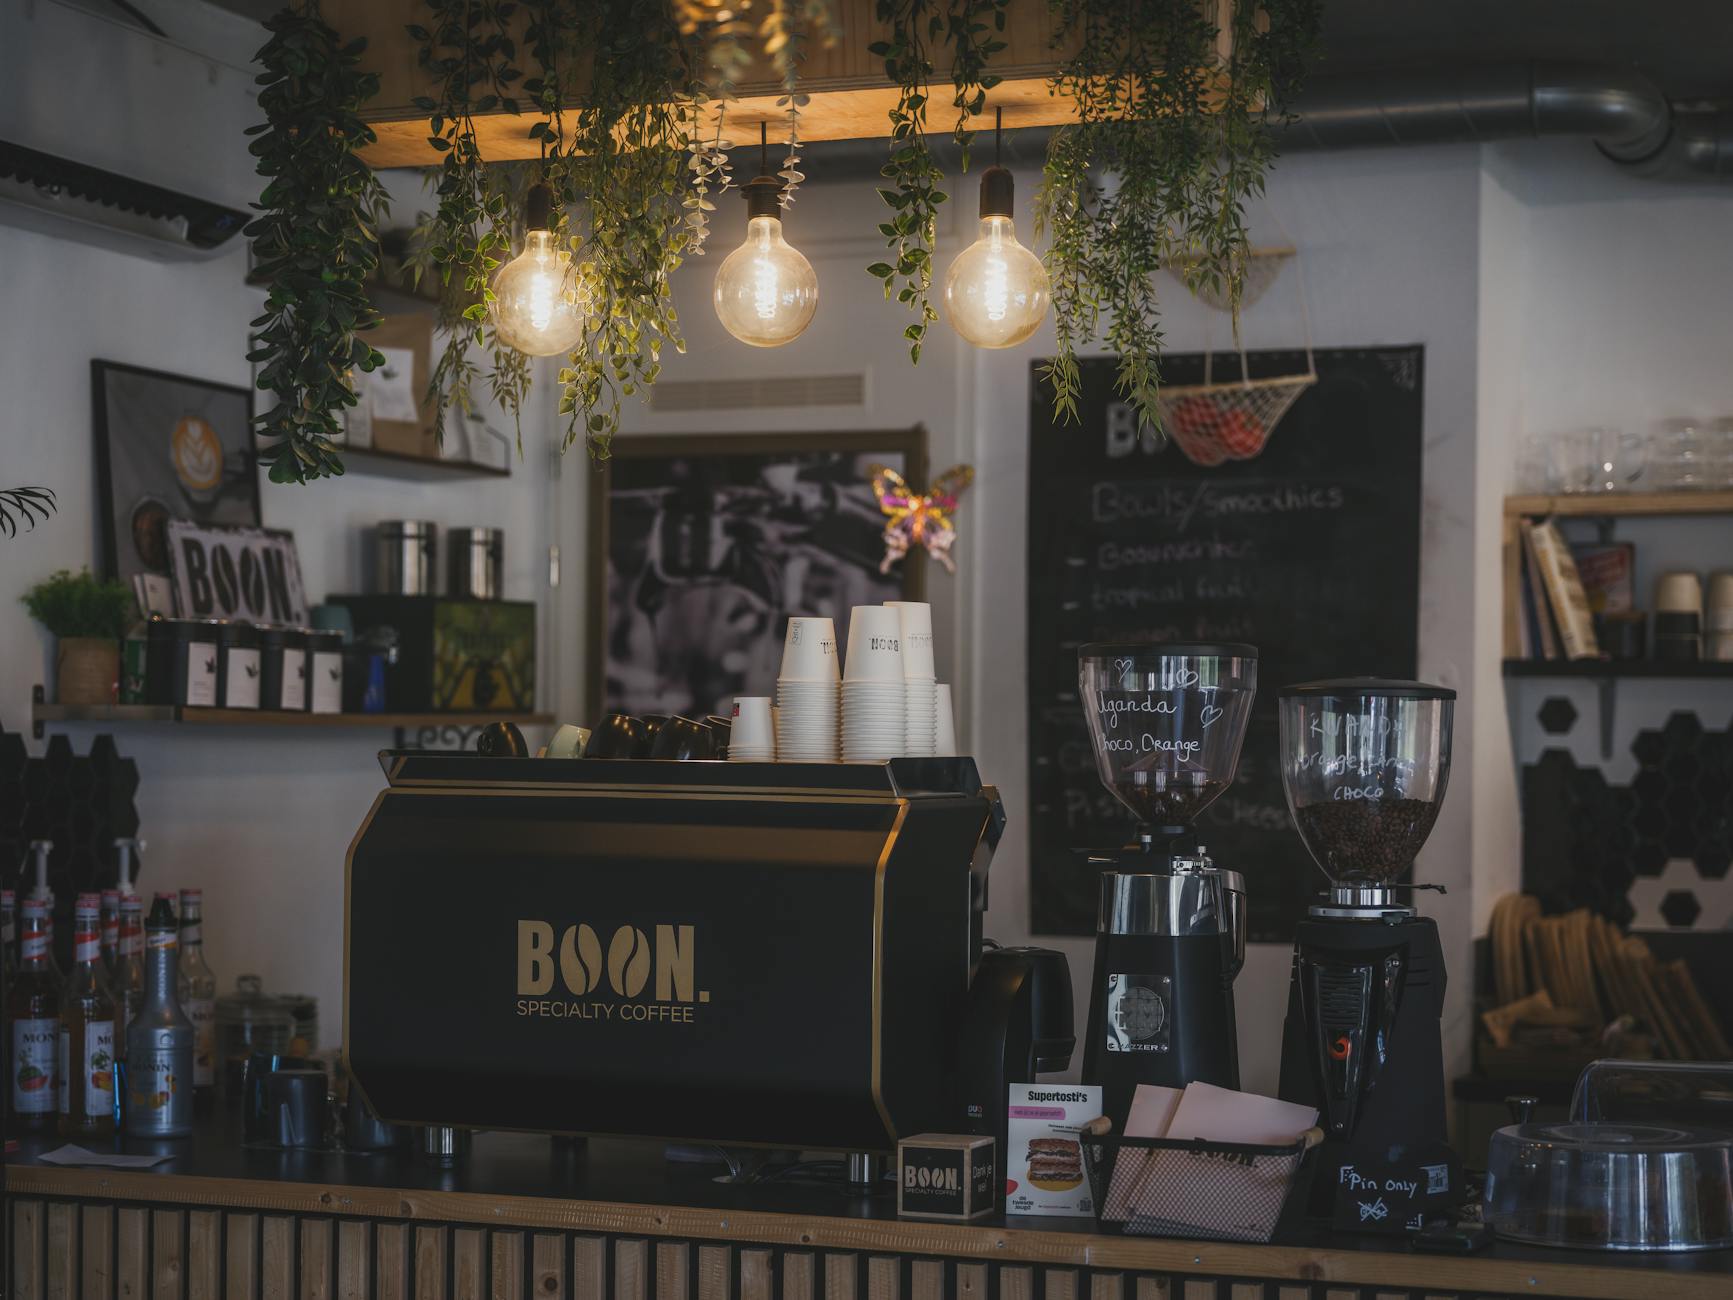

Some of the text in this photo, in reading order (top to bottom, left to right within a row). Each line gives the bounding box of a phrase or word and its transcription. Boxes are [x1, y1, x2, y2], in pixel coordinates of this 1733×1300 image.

[181, 537, 301, 623] BOON.
[517, 919, 710, 1003] BOON.
[516, 1000, 695, 1023] SPECIALTY COFFEE
[1028, 1090, 1088, 1103] Supertosti's
[904, 1165, 962, 1191] BOON.
[1349, 1172, 1378, 1191] Pin
